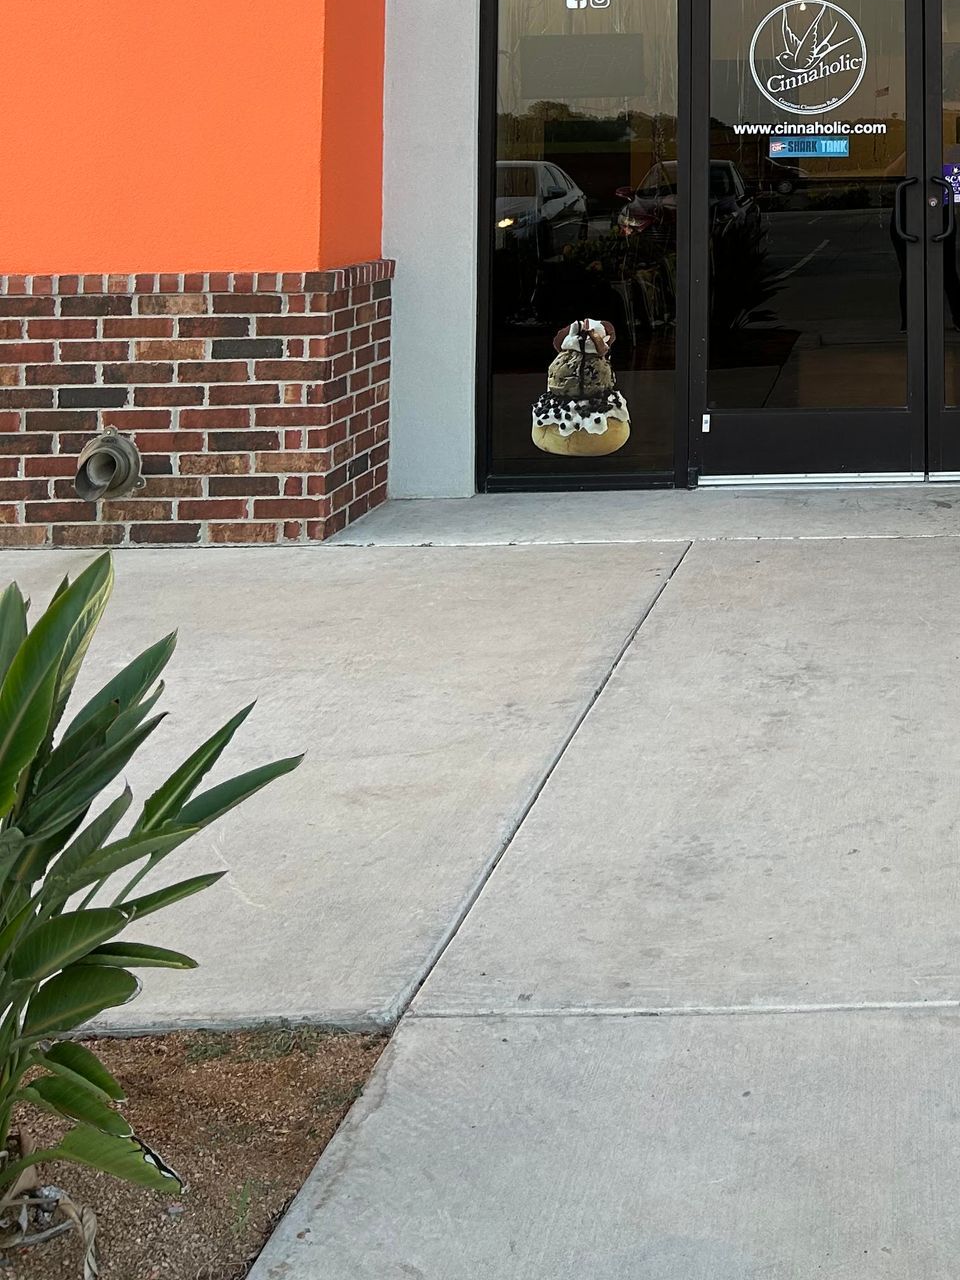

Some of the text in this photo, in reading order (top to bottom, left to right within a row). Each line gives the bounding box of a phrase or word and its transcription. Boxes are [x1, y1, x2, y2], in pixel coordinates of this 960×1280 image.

[766, 53, 860, 93] Cinnaholic
[733, 121, 887, 134] www.cinnaholic.com
[788, 140, 818, 152] SHARK
[821, 140, 847, 152] TANK
